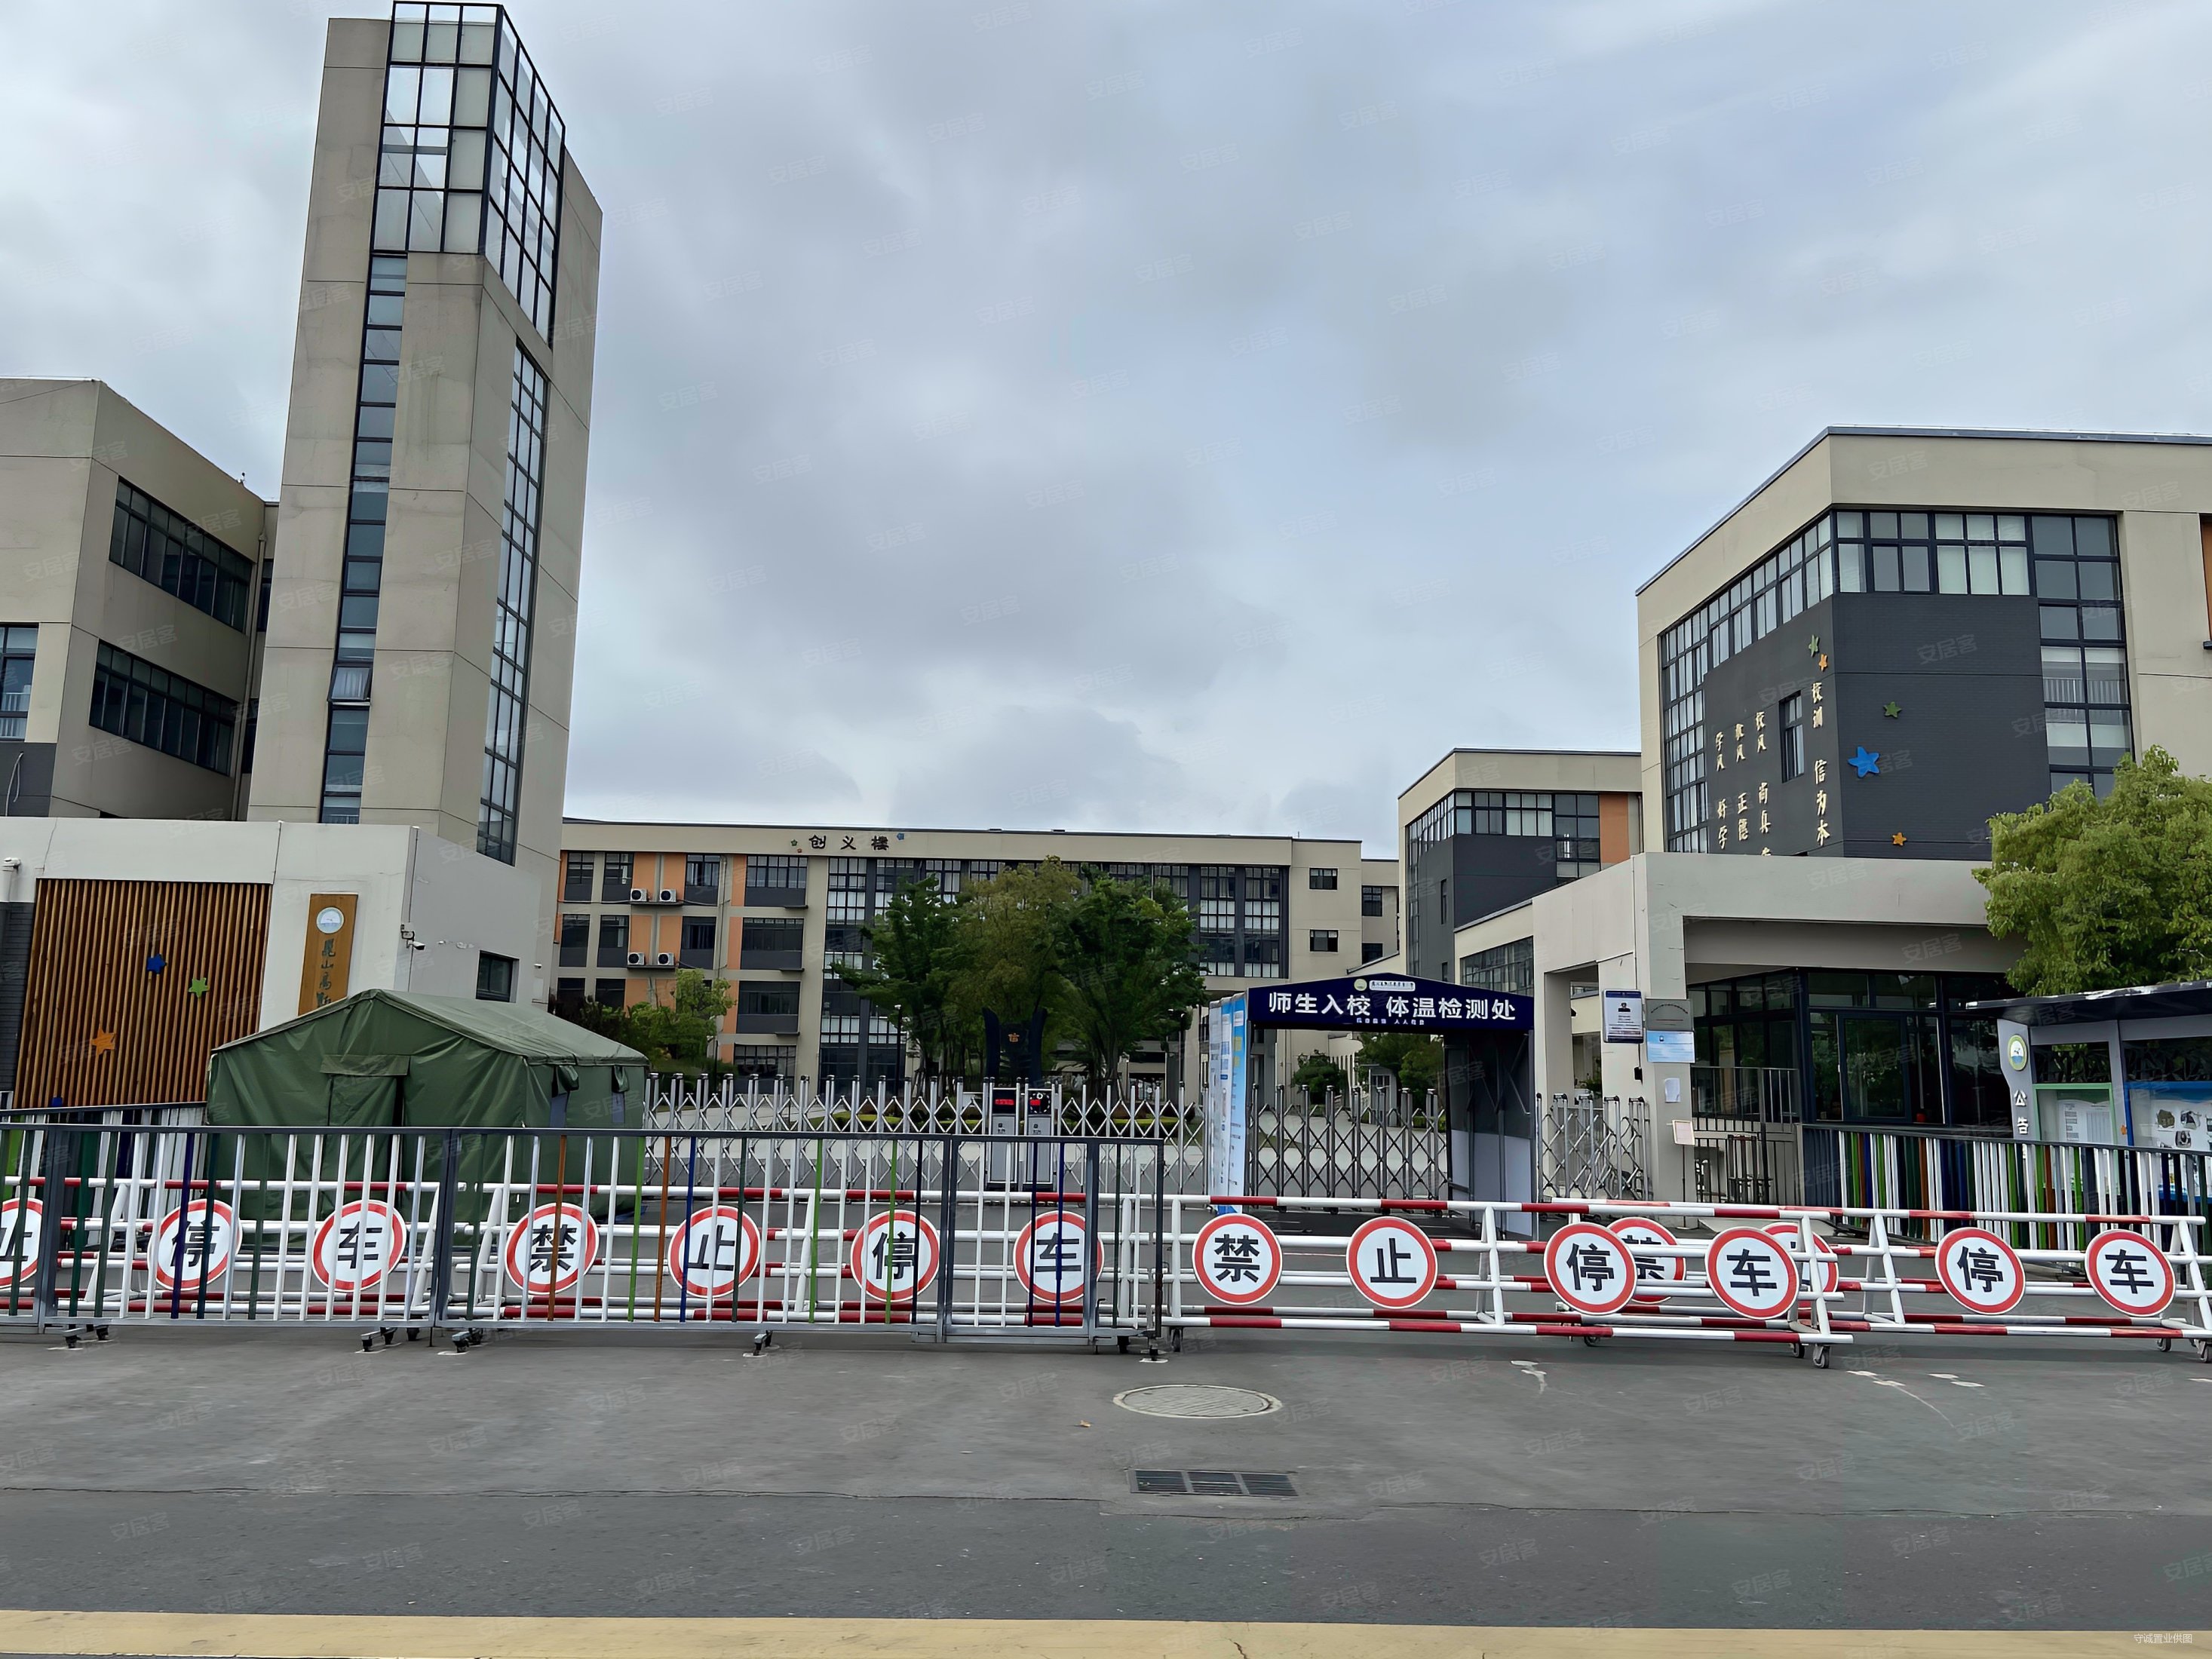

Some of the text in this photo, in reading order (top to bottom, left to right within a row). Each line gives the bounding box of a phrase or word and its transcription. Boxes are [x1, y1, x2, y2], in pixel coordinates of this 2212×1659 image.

[1269, 992, 1516, 1020] 师生入校 体温检测处
[2014, 1090, 2029, 1134] 公告
[170, 1219, 220, 1267] 停
[338, 1221, 383, 1268] 车
[529, 1224, 1081, 1280] 禁 止 停 车
[1214, 1234, 1260, 1283] 禁
[1370, 1237, 1416, 1283] 止
[1566, 1243, 1614, 1292] 停
[1726, 1248, 1778, 1296] 车
[1957, 1246, 2154, 1294] 停 车
